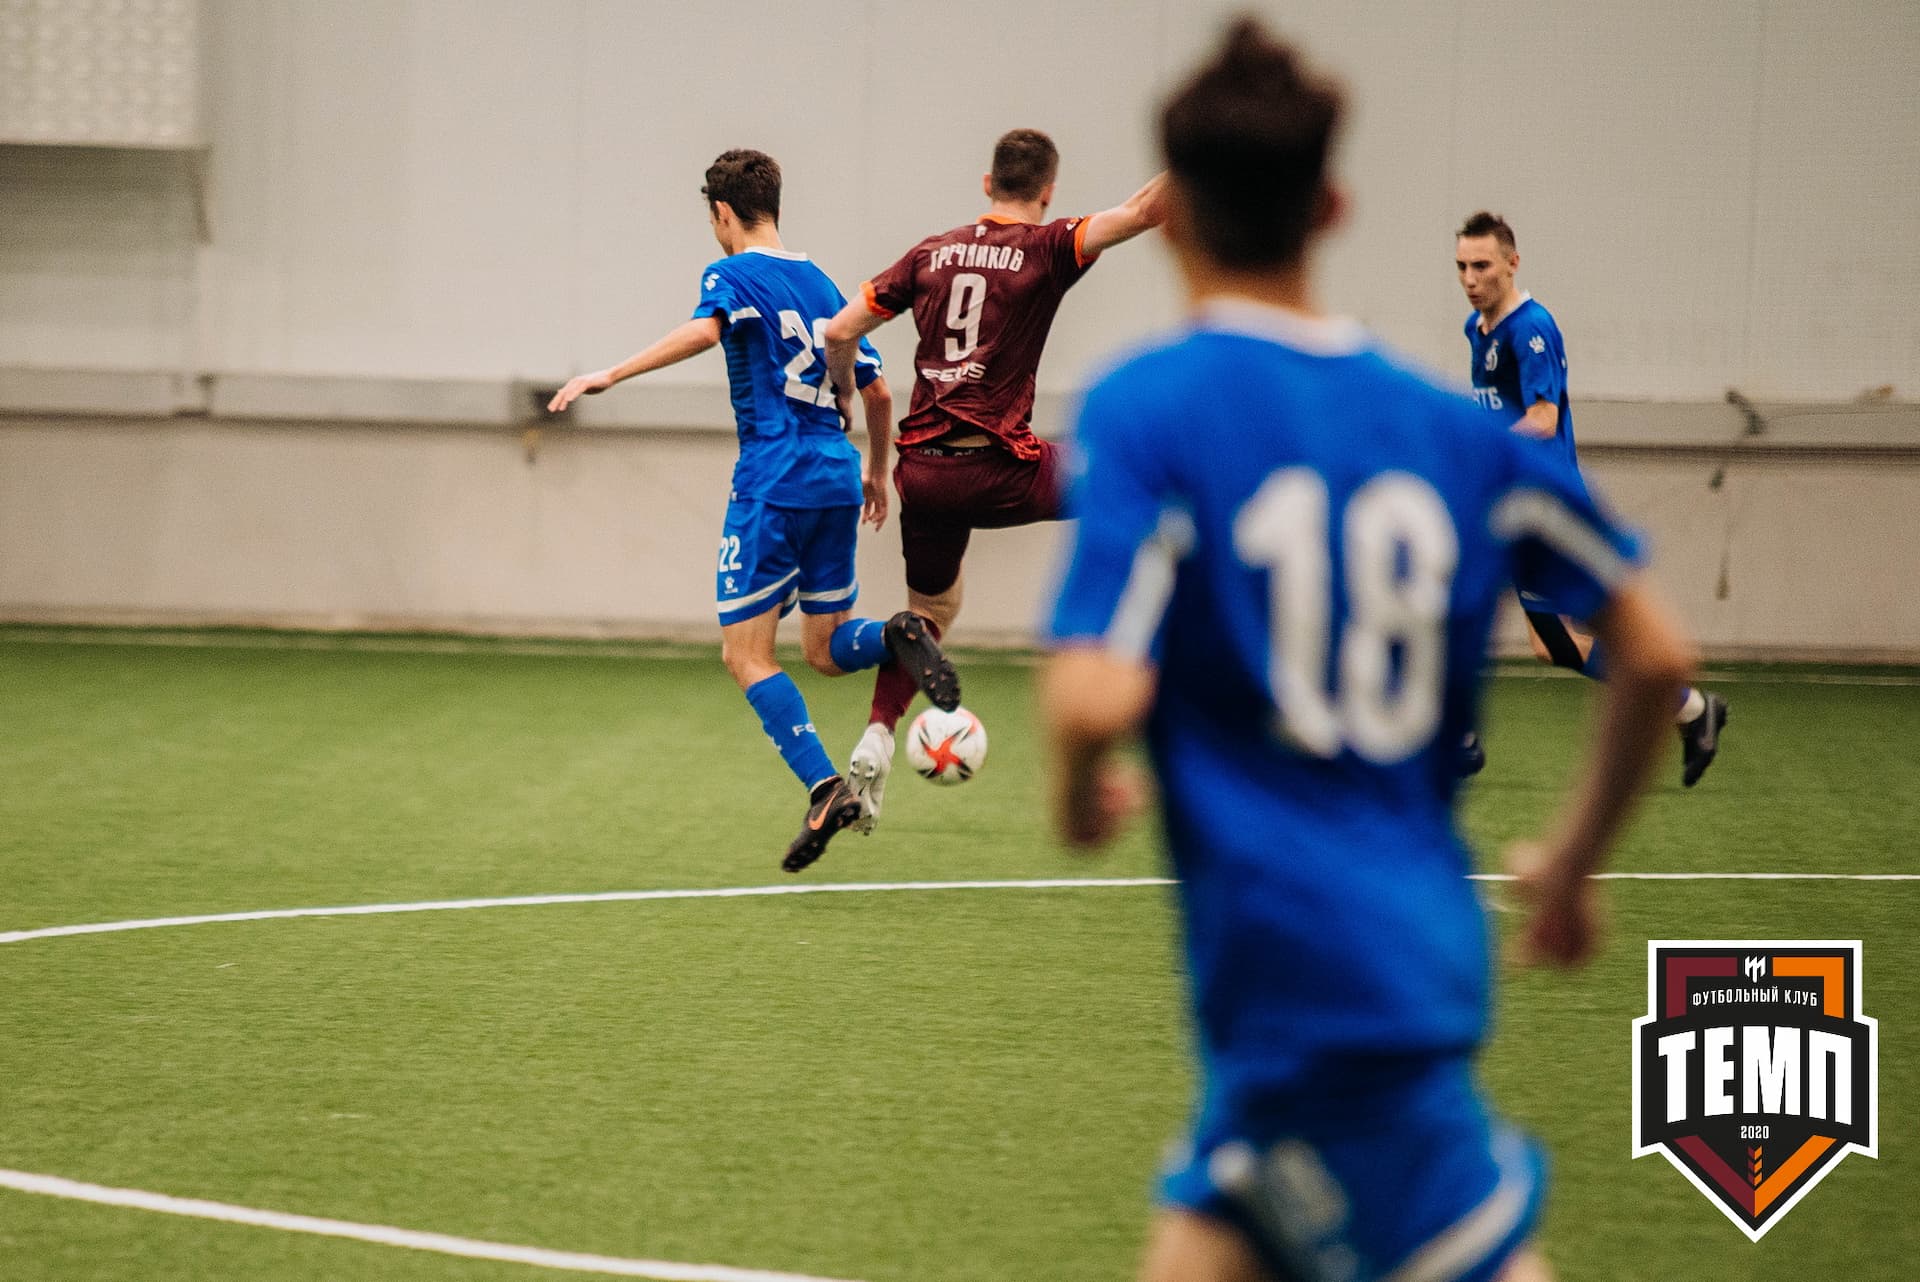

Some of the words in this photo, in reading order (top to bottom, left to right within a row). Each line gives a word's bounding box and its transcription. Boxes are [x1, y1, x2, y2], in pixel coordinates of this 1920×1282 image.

[945, 273, 987, 362] 9
[719, 534, 742, 572] 22
[1232, 465, 1459, 764] 18
